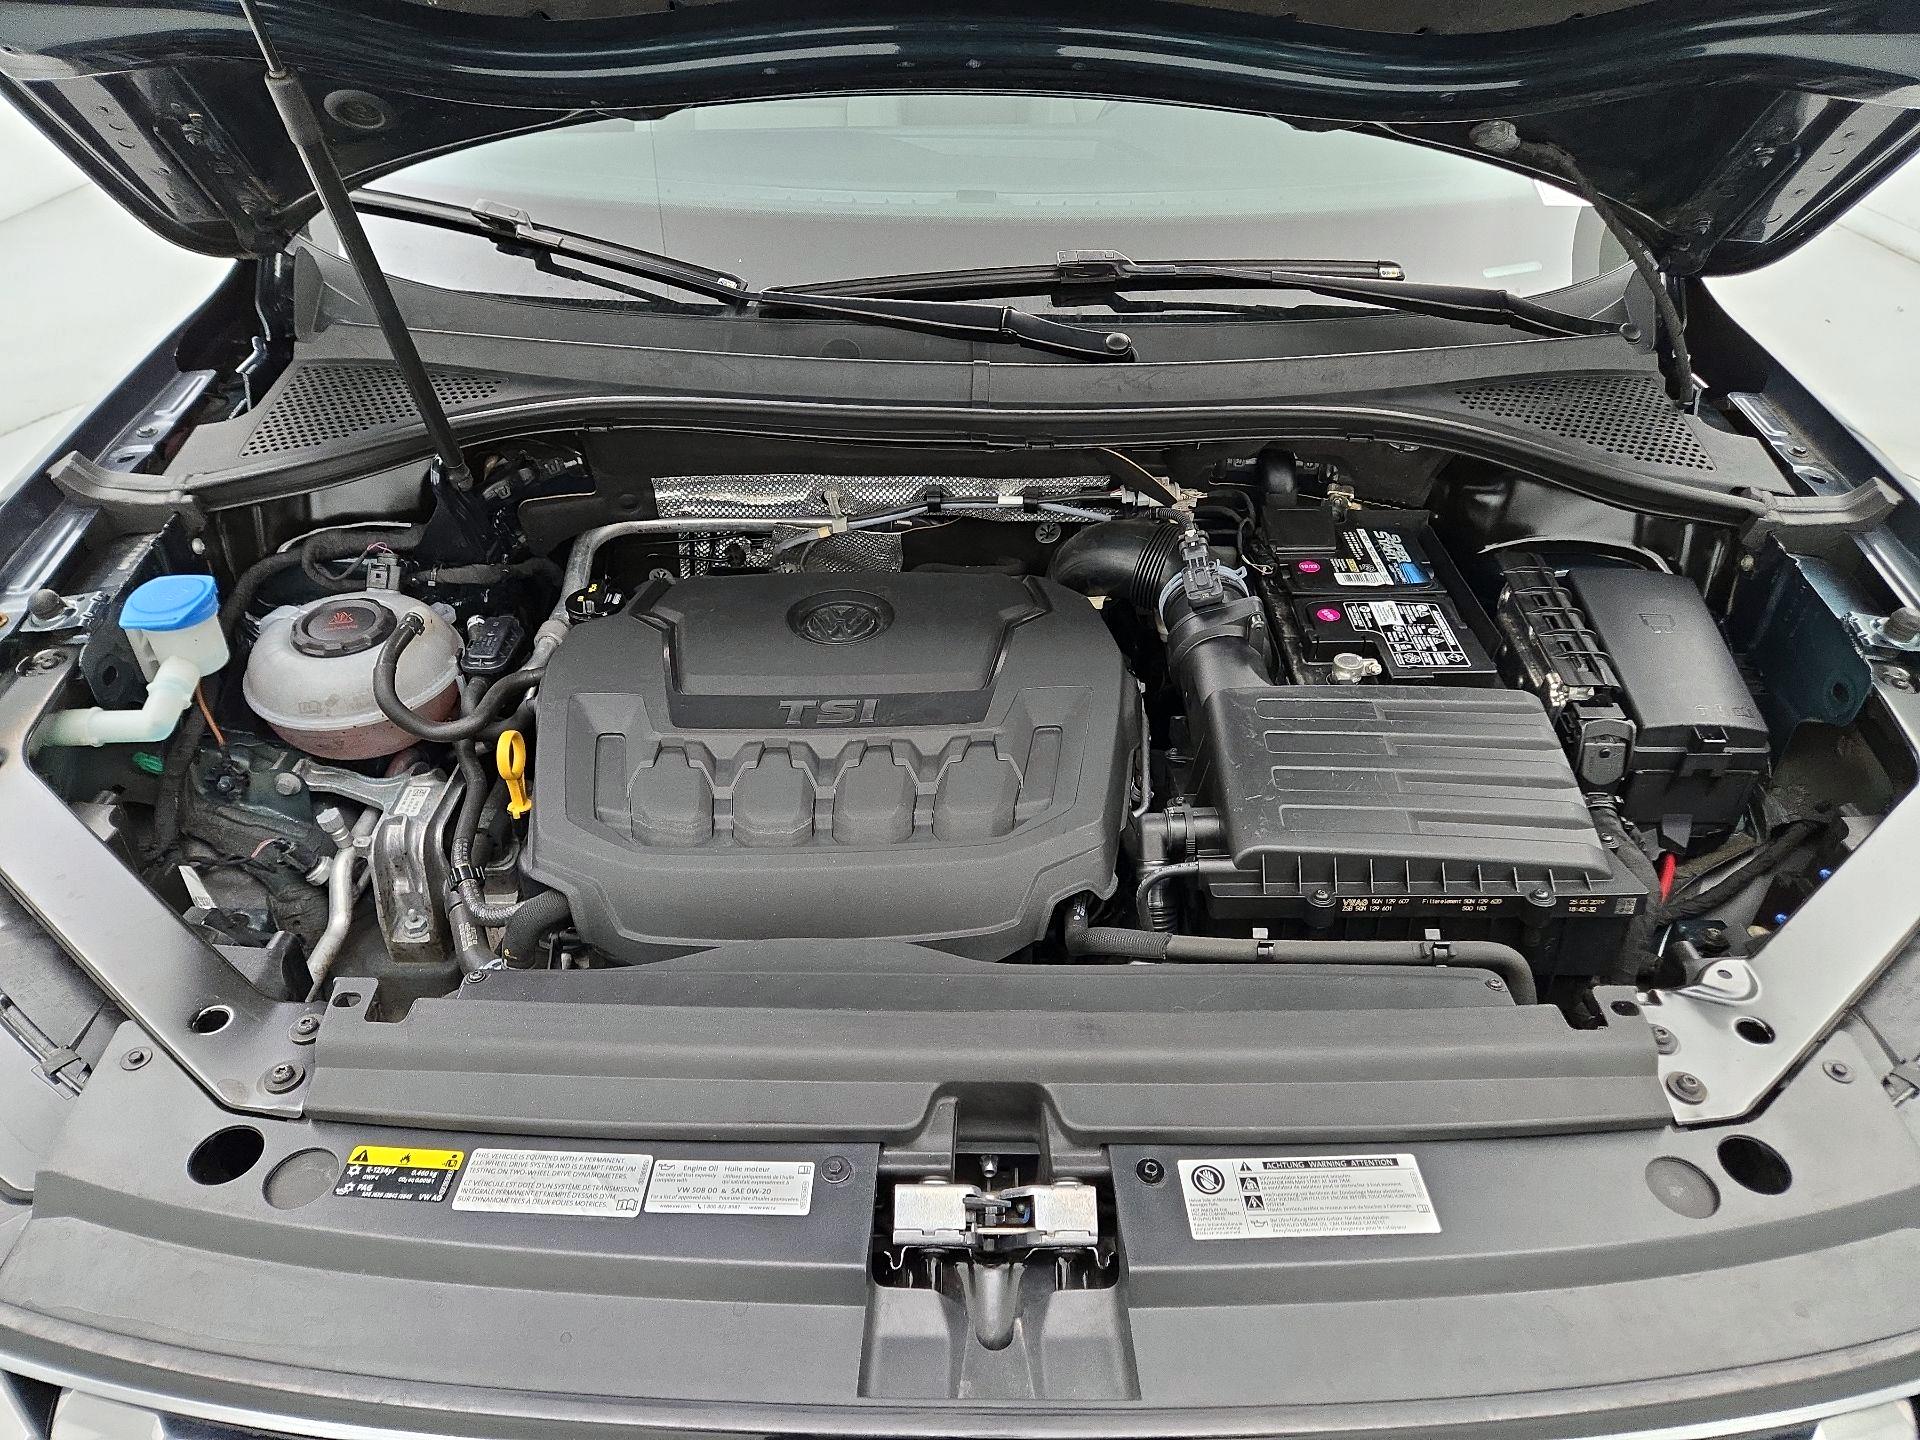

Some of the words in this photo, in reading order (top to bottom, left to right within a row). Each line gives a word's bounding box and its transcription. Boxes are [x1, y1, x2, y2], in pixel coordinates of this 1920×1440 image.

[779, 699, 880, 724] TSI
[472, 1160, 507, 1168] ALL-WHEEL
[529, 1161, 555, 1169] SYSTEM
[1308, 1160, 1347, 1168] WARNING
[1351, 1159, 1393, 1167] ATTENTION
[510, 1169, 551, 1177] TWO-WHEEL
[684, 1165, 707, 1173] Engine
[357, 1184, 374, 1192] PAG
